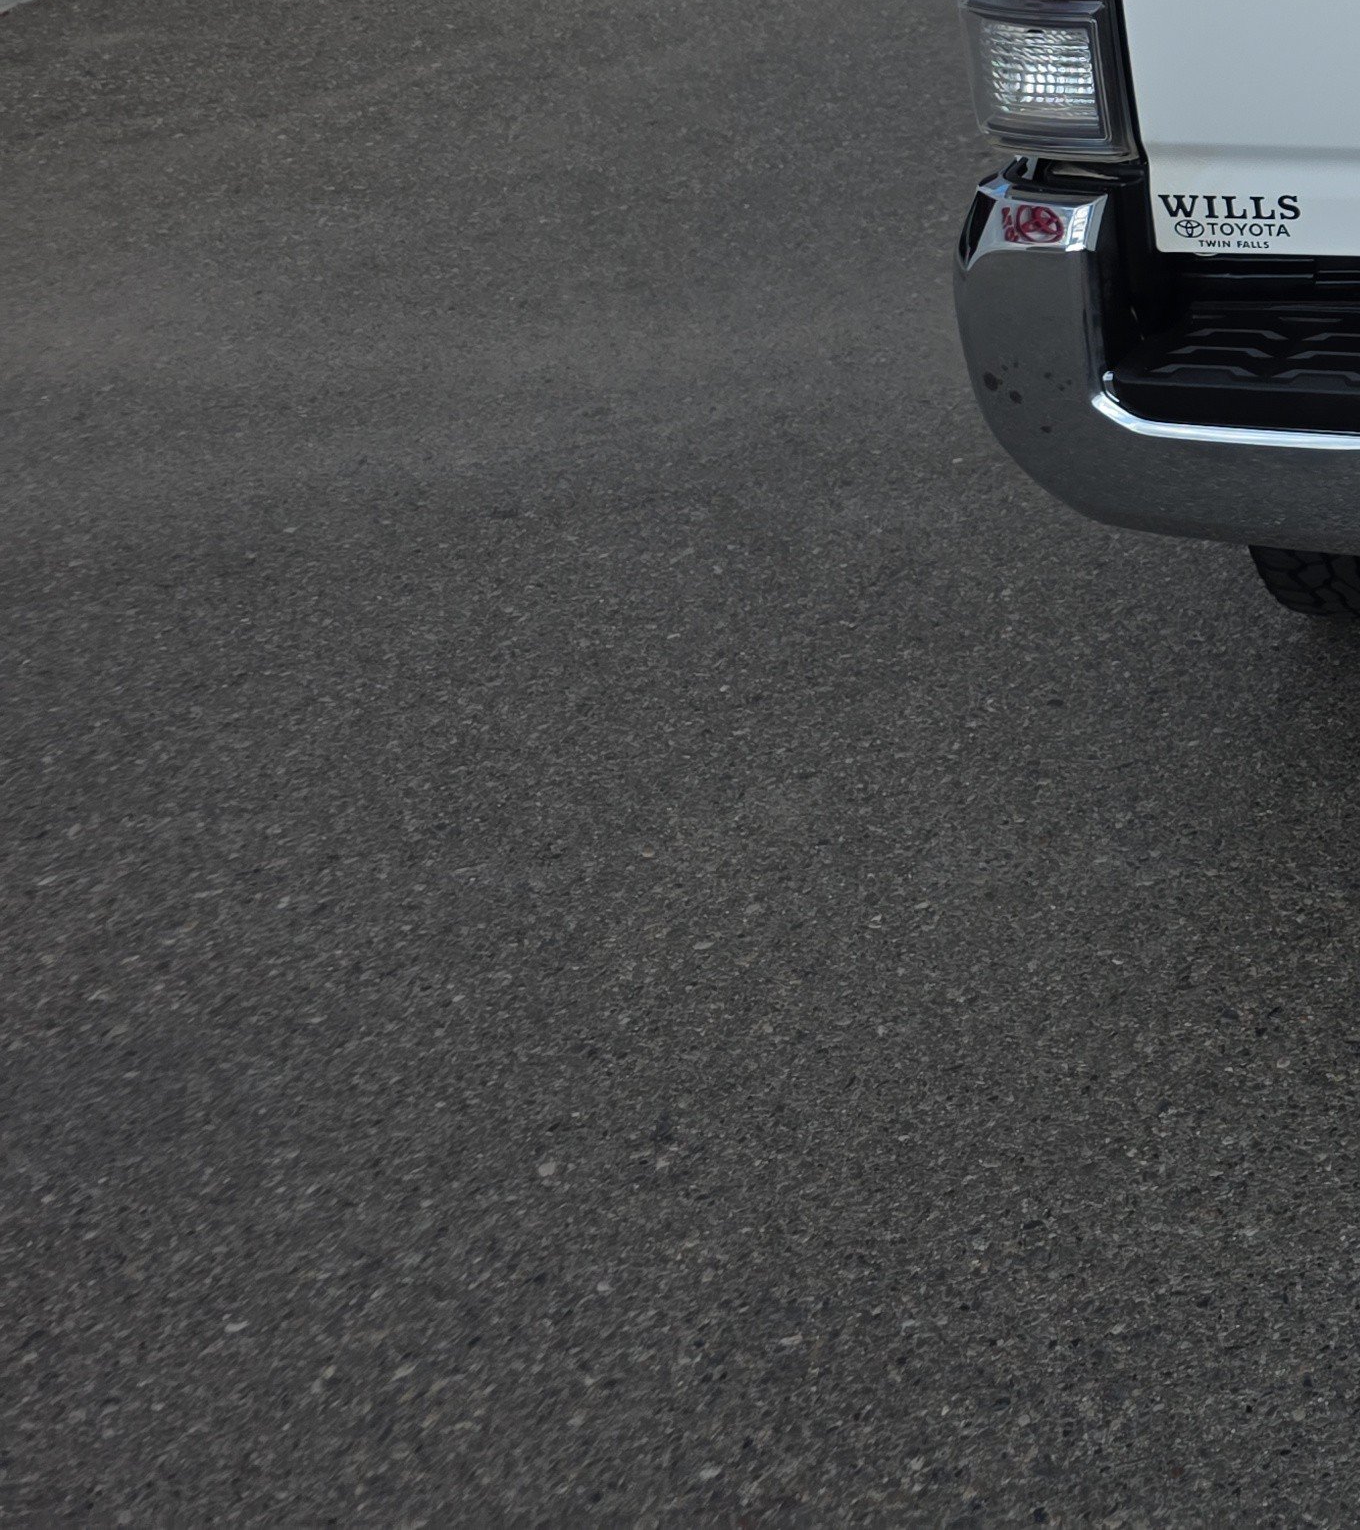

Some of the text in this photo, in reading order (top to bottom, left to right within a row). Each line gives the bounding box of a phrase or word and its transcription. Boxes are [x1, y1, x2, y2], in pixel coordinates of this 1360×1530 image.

[1157, 194, 1301, 220] WILLS
[1206, 222, 1291, 237] TOYOTA
[1198, 239, 1270, 249] TWIN FALLS
